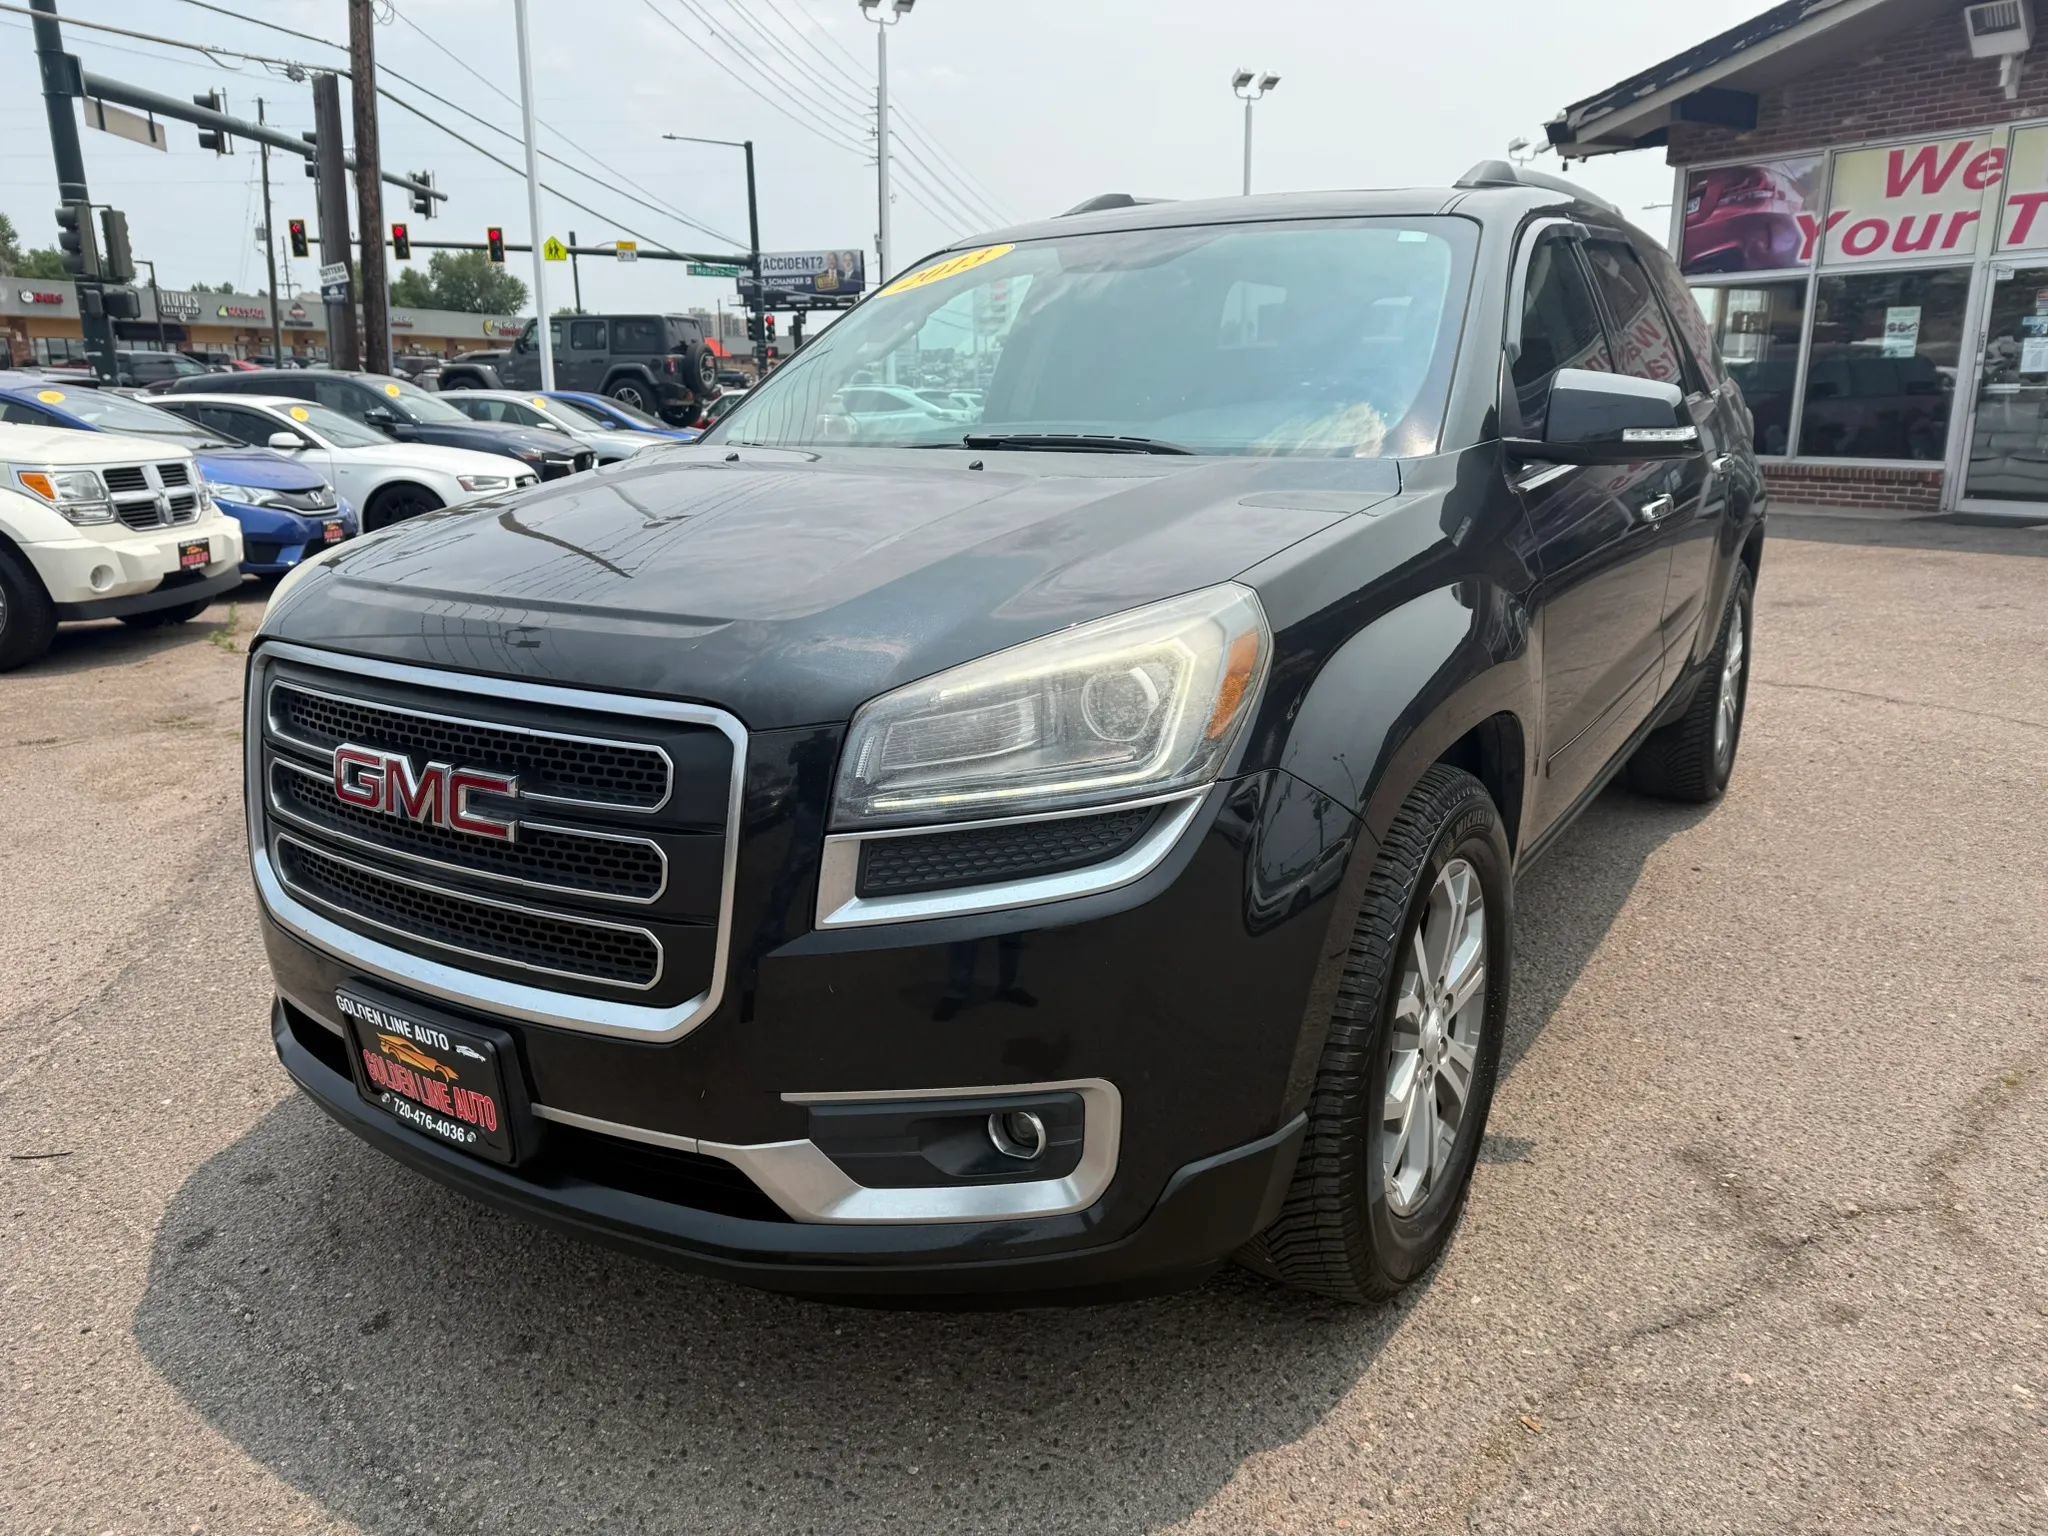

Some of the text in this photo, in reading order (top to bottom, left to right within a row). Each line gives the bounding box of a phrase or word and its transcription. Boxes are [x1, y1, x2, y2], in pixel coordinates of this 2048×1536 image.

[1886, 141, 2006, 198] We
[1796, 210, 1981, 259] Your
[763, 256, 823, 271] ACCIDENT?
[334, 742, 519, 843] GMC
[335, 995, 449, 1051] GOLDEN LINE AUTO
[362, 1049, 497, 1132] GOLDEN LINE AUTO
[393, 1097, 465, 1142] 720-476-4036
